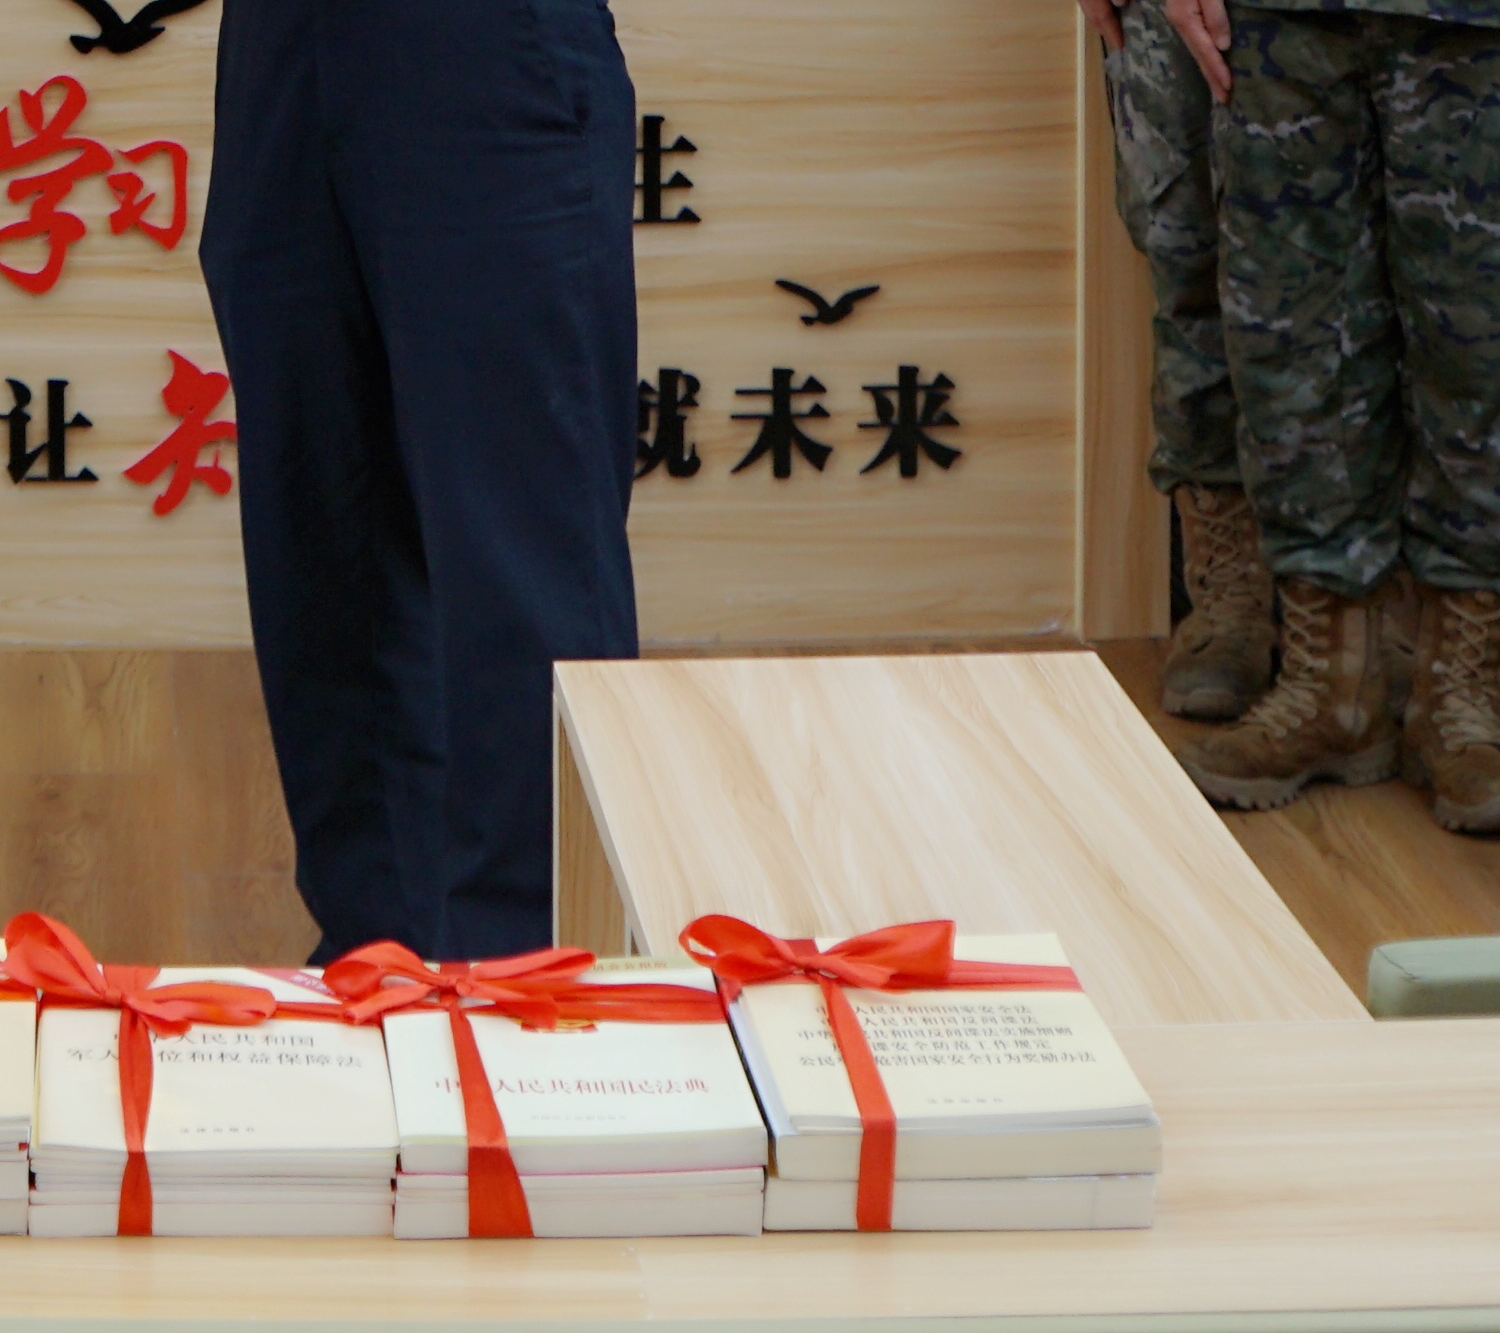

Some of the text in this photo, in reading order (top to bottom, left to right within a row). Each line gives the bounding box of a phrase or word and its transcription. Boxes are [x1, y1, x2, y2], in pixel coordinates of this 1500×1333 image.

[815, 1004, 1032, 1015] 中人民共和国国家安全法
[113, 1032, 315, 1047] 人民共和国
[65, 1047, 363, 1068] 军人位和权益保障法
[435, 1078, 710, 1095] 中人民共和国民法典
